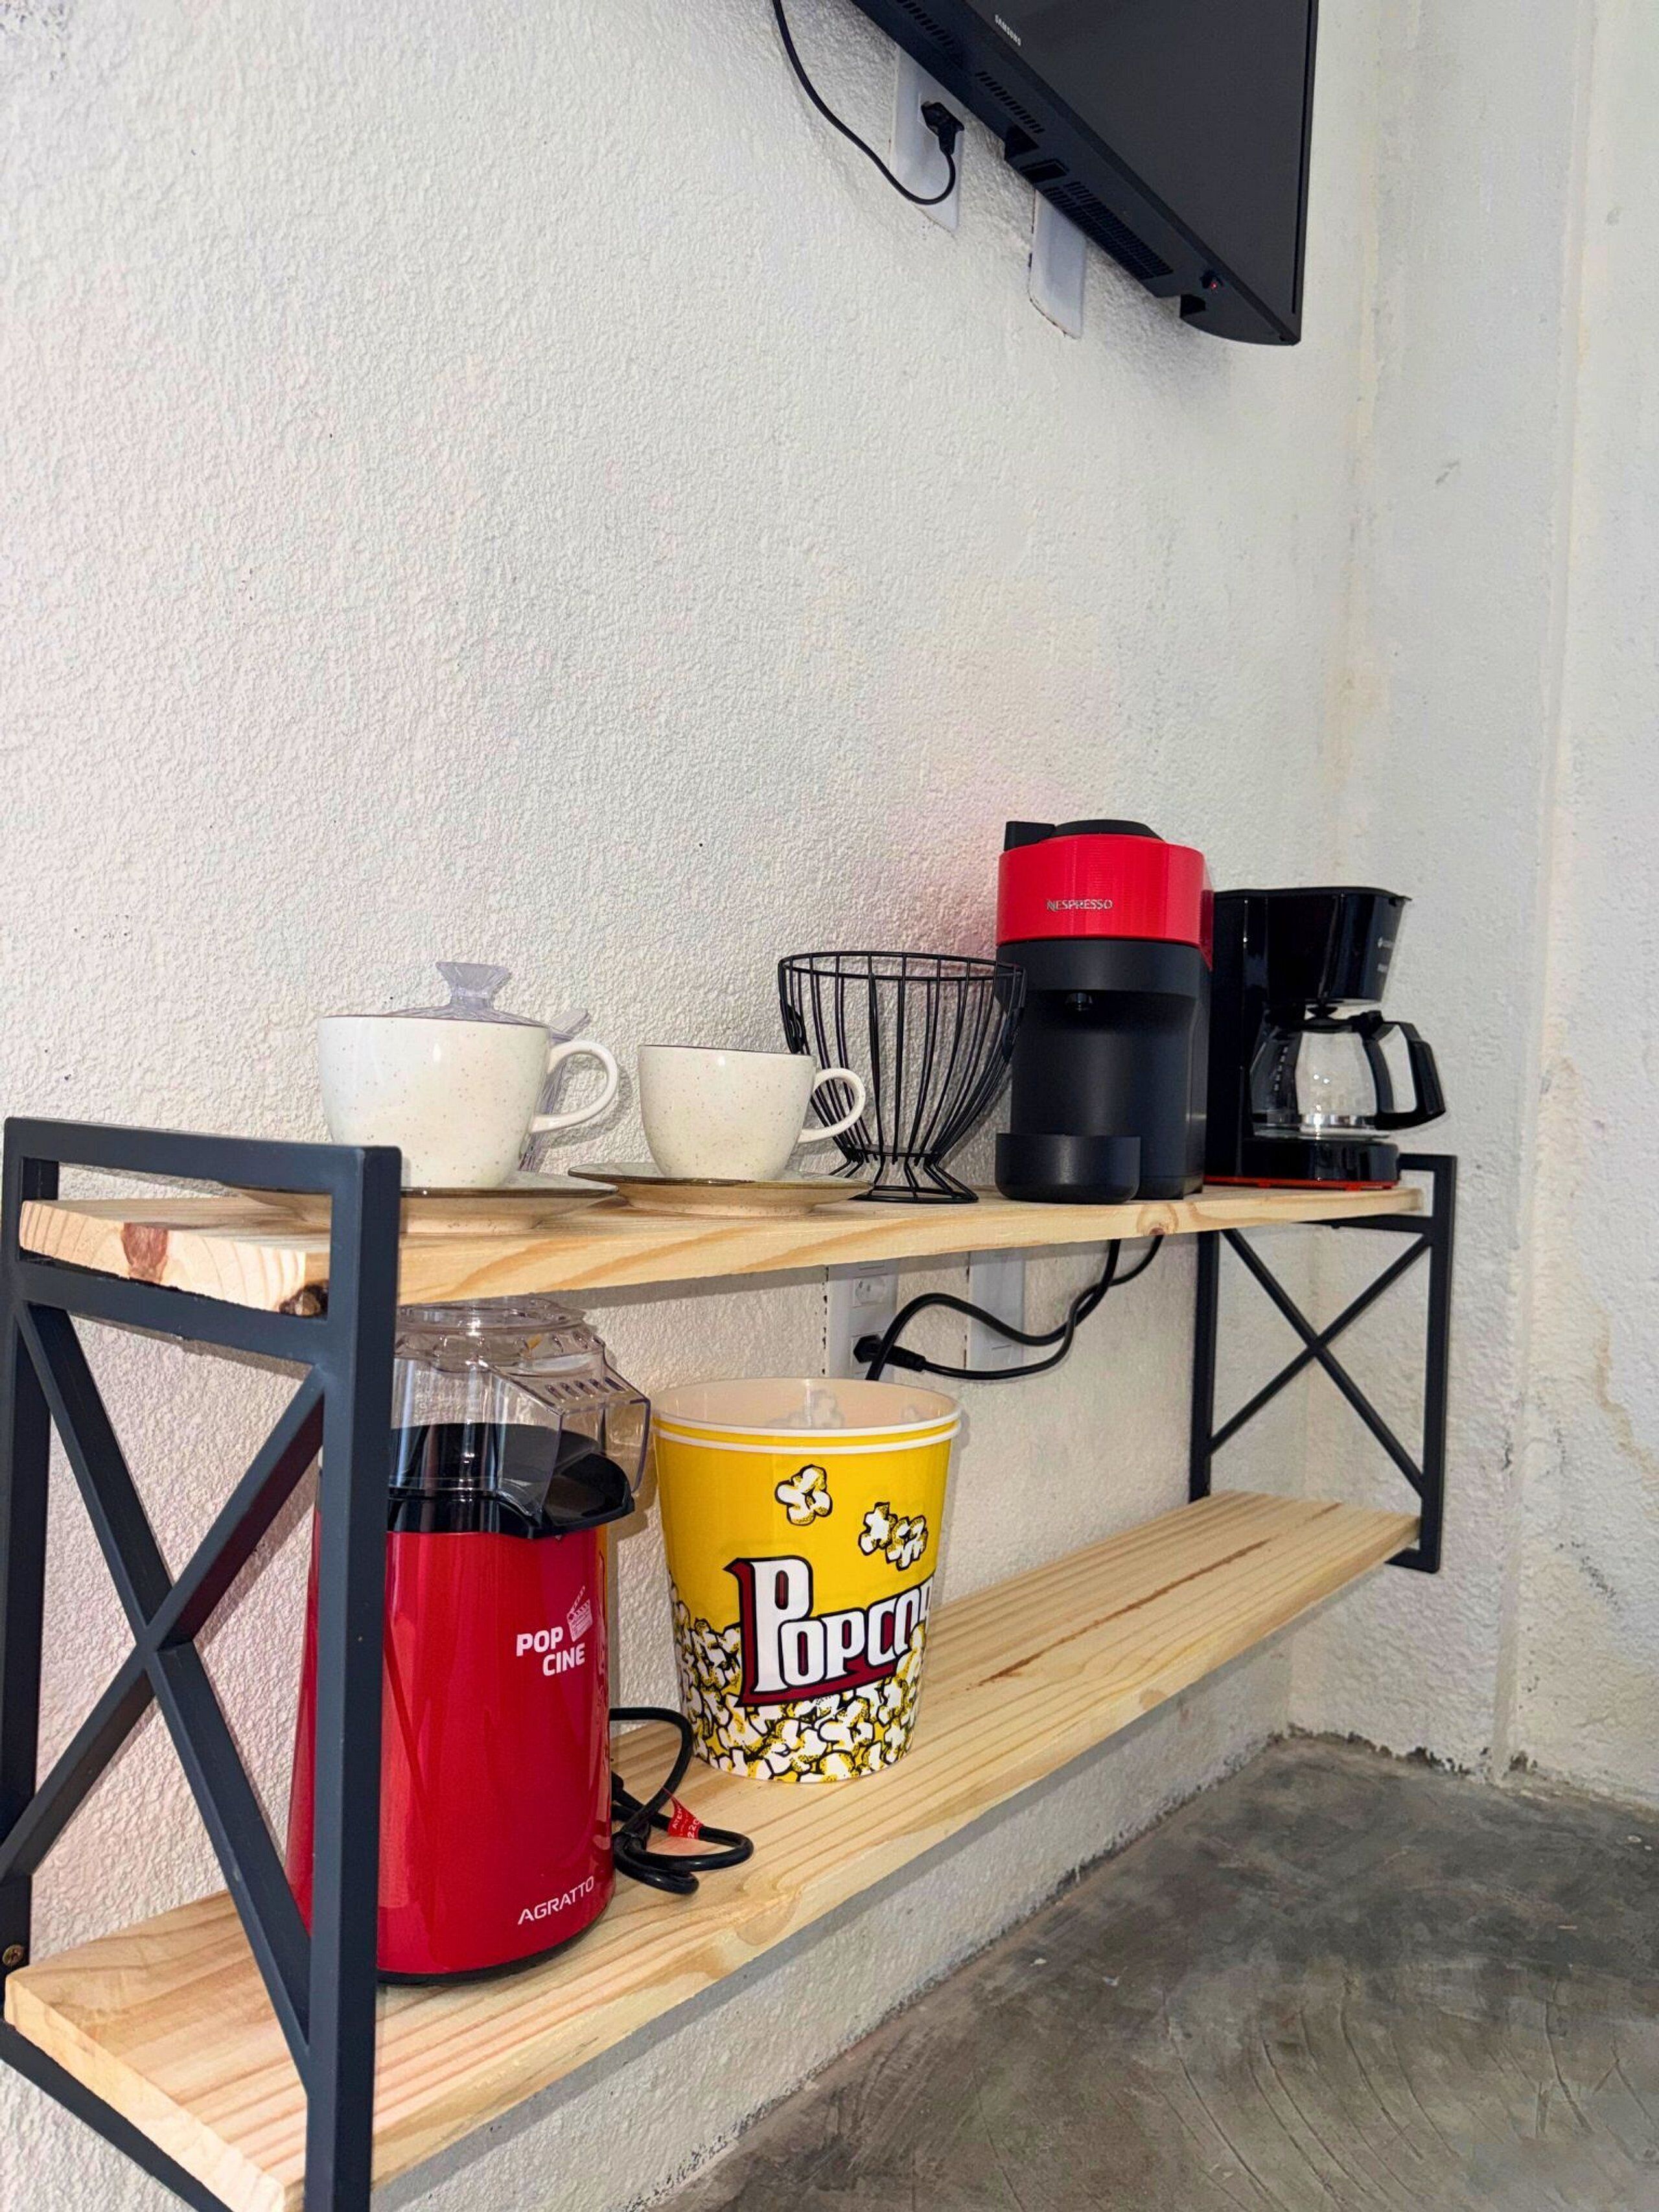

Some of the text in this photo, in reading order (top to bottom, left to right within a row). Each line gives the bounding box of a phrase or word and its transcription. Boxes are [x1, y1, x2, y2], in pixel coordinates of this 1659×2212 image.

[1047, 898, 1113, 912] NESPRESSO
[516, 1625, 564, 1657] POP
[542, 1642, 586, 1677] CINE
[517, 1875, 595, 1926] AGRATTO
